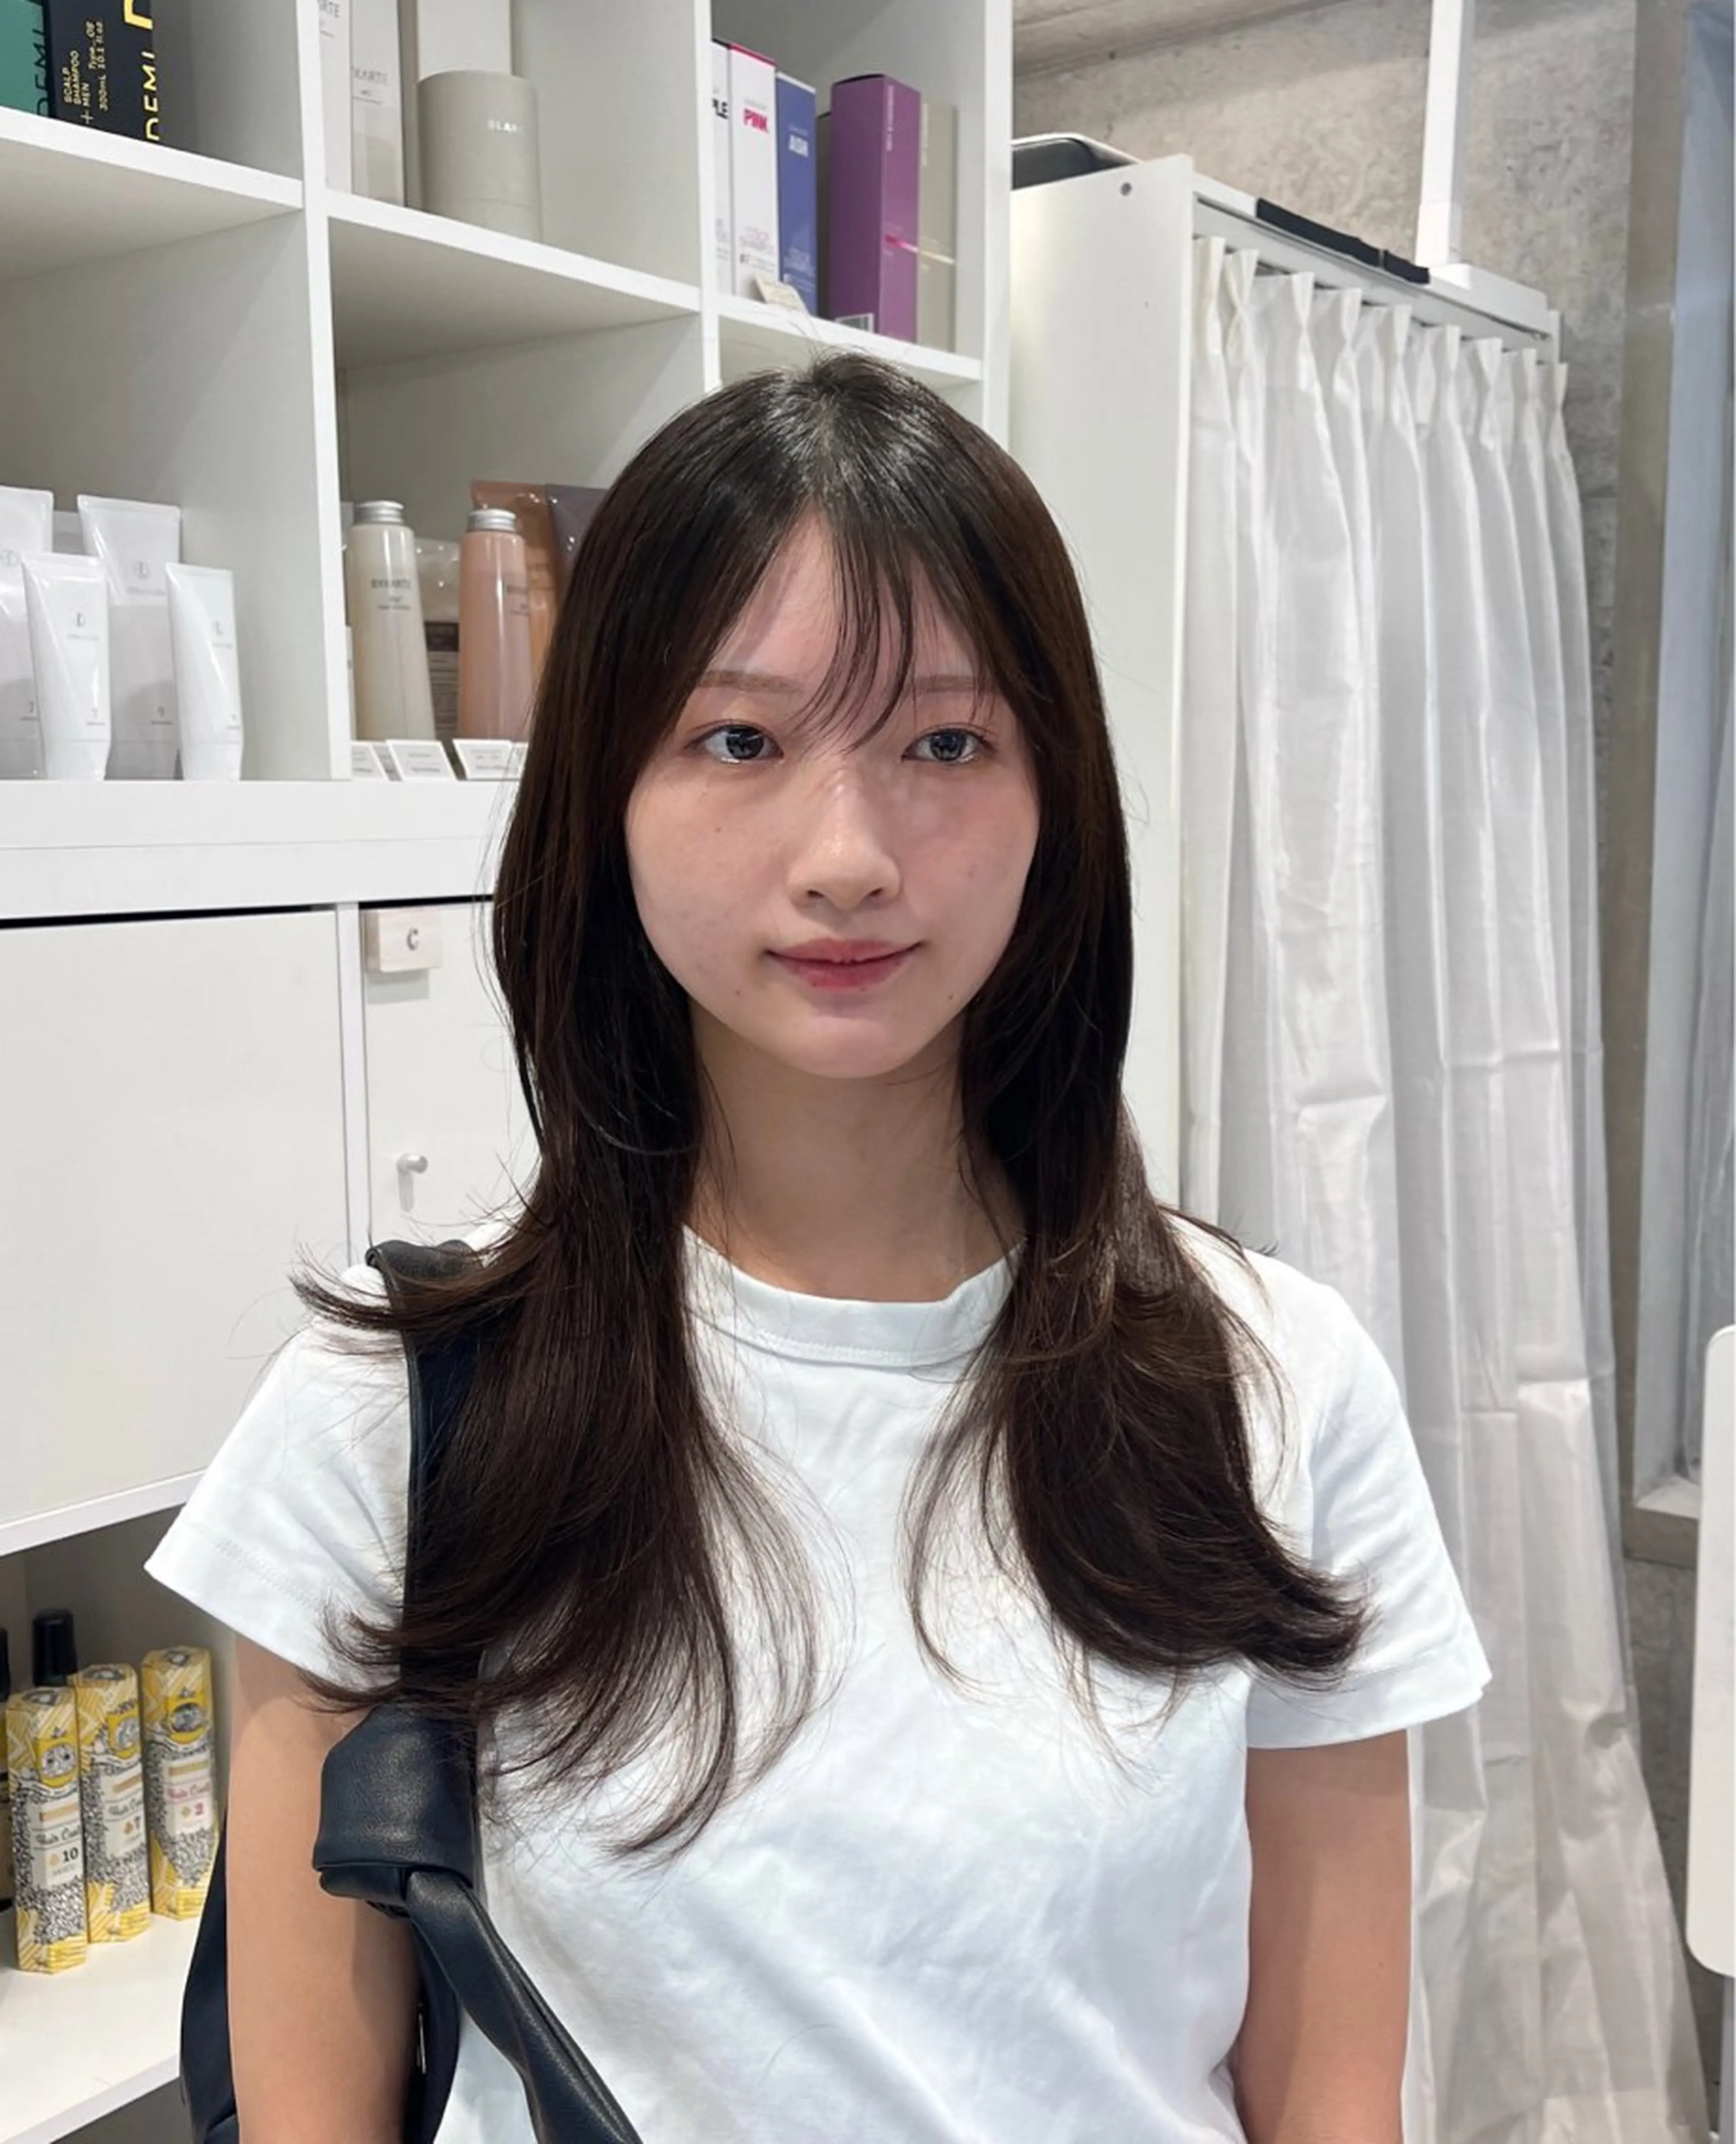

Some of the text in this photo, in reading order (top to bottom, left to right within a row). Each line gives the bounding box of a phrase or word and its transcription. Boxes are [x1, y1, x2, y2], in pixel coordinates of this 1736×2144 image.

[62, 67, 72, 103] SCALP
[69, 50, 81, 104] SHAMPOO
[81, 82, 91, 108] MEN
[744, 108, 769, 134] PINK
[406, 929, 420, 951] C
[63, 1846, 79, 1862] 10
